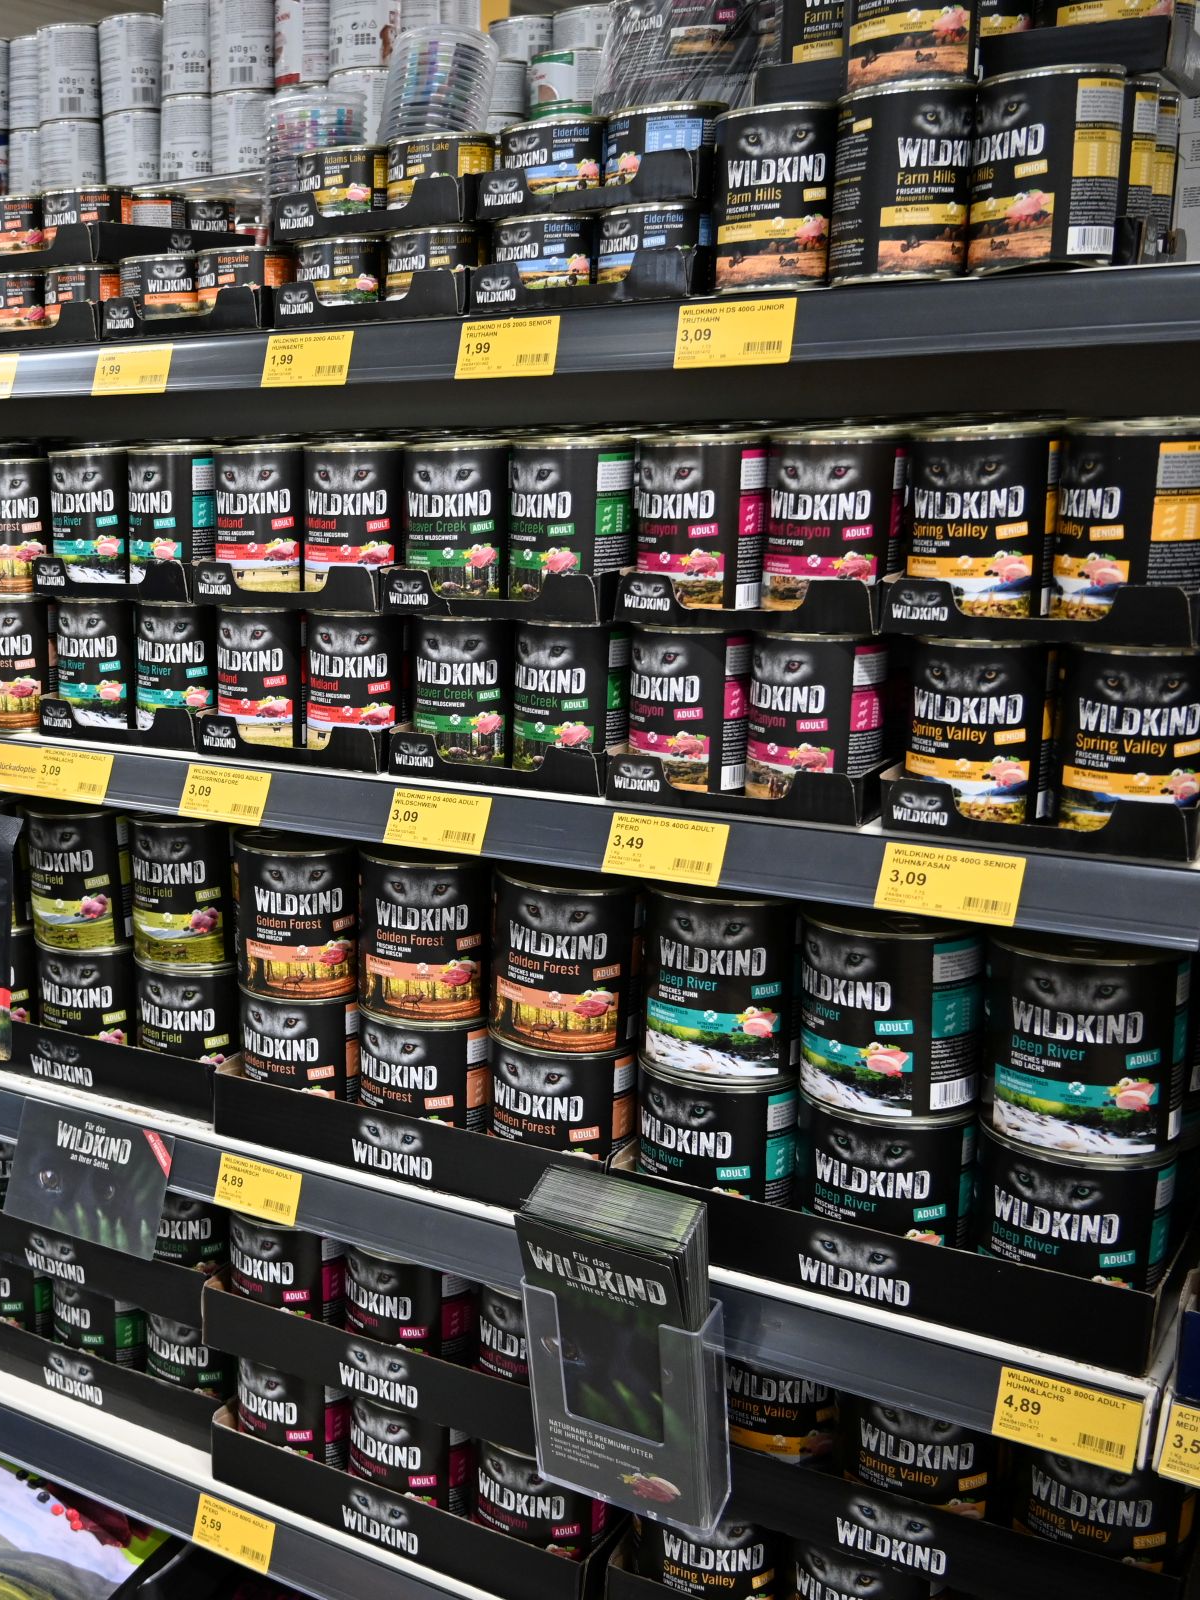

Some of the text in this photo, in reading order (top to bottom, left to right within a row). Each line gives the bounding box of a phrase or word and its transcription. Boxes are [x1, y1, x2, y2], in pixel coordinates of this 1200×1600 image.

[552, 126, 590, 137] Elderfield
[407, 141, 449, 152] Adams Lake
[504, 149, 547, 170] WILDKIND
[728, 153, 826, 188] WILDKIND
[483, 191, 523, 207] WILDKIND
[727, 188, 782, 205] Farm Hills
[727, 203, 780, 214] FRISCHER TRUTHAHN
[217, 254, 249, 264] Kingsville
[148, 278, 193, 293] WILDKIND
[682, 308, 717, 316] WILDKIND
[757, 304, 785, 312] JUNIOR
[682, 316, 720, 324] TRUTHAHN
[681, 328, 712, 342] 3,09
[465, 342, 490, 355] 1,99
[271, 355, 293, 366] 1,99
[101, 365, 121, 376] 1,99
[408, 490, 492, 518] WILDKIND
[771, 489, 872, 521] WILDKIND
[914, 485, 1025, 520] WILDKIND
[787, 525, 830, 540] Canyon
[845, 526, 871, 538] ADULT
[913, 522, 988, 540] Spring Valley
[137, 640, 205, 663] WILDKIND
[154, 664, 171, 676] River
[188, 667, 207, 677] ADULT
[310, 651, 388, 678] WILDKIND
[417, 656, 498, 685] WILDKIND
[311, 678, 338, 691] Midland
[369, 682, 389, 692] ADULT
[417, 686, 473, 700] Beaver Creek
[478, 689, 499, 700] ADULT
[41, 765, 60, 776] 3,09
[189, 784, 211, 796] 3,09
[395, 799, 437, 808] WILDSCHWEIN
[392, 810, 418, 822] 3,09
[617, 815, 652, 826] WILDKIND
[671, 821, 689, 830] 400G
[691, 824, 716, 833] ADULT
[616, 823, 640, 832] PFERD
[613, 835, 644, 850] 3,49
[892, 857, 951, 871] HUHN&FASAN
[894, 848, 935, 861] WILDKIND
[946, 854, 958, 863] DS
[960, 856, 981, 865] 400G
[983, 859, 1017, 870] SENIOR
[132, 855, 206, 885] WILDKIND
[889, 870, 927, 887] 3,09
[152, 886, 173, 898] Field
[198, 889, 219, 900] ADULT
[254, 886, 343, 916] WILDKIND
[256, 916, 322, 930] Golden Forest
[458, 937, 481, 949] ADULT
[660, 936, 767, 977] WILDKIND
[659, 970, 717, 992] Deep River
[1012, 997, 1144, 1044] WILDKIND
[1012, 1034, 1085, 1061] Deep River
[1011, 1051, 1061, 1068] FRISCHES HUHN
[1011, 1058, 1045, 1073] UND LACHS
[1130, 1052, 1157, 1066] ADULT
[85, 1121, 106, 1134] Für das
[57, 1120, 132, 1165] WILDKIND
[70, 1153, 110, 1171] an Ihrer Seite.
[351, 1138, 433, 1182] WILDKIND
[222, 1174, 243, 1187] 4,89
[25, 1248, 85, 1285] WILDKIND
[573, 1251, 611, 1270] Für das
[527, 1241, 667, 1306] WILDKIND
[799, 1254, 910, 1307] WILDKIND
[566, 1281, 639, 1308] an Ihrer Seite.
[1006, 1381, 1065, 1402] HUHN&LACHS
[1007, 1371, 1050, 1389] WILDKIND
[1059, 1386, 1072, 1395] DS
[1074, 1390, 1095, 1401] 800G
[1098, 1397, 1127, 1410] ADULT
[1003, 1394, 1041, 1415] 4,89
[1176, 1421, 1198, 1432] MEDI
[549, 1419, 592, 1439] NATURNAHES
[595, 1434, 654, 1460] PREMIUMFUTTER
[550, 1426, 605, 1450] FÜR IHREN HUND
[860, 1417, 974, 1470] WILDKIND
[860, 1451, 939, 1488] Spring Valley
[201, 1514, 222, 1532] 5,59
[342, 1504, 419, 1556] WILDKIND
[836, 1517, 947, 1576] WILDKIND
